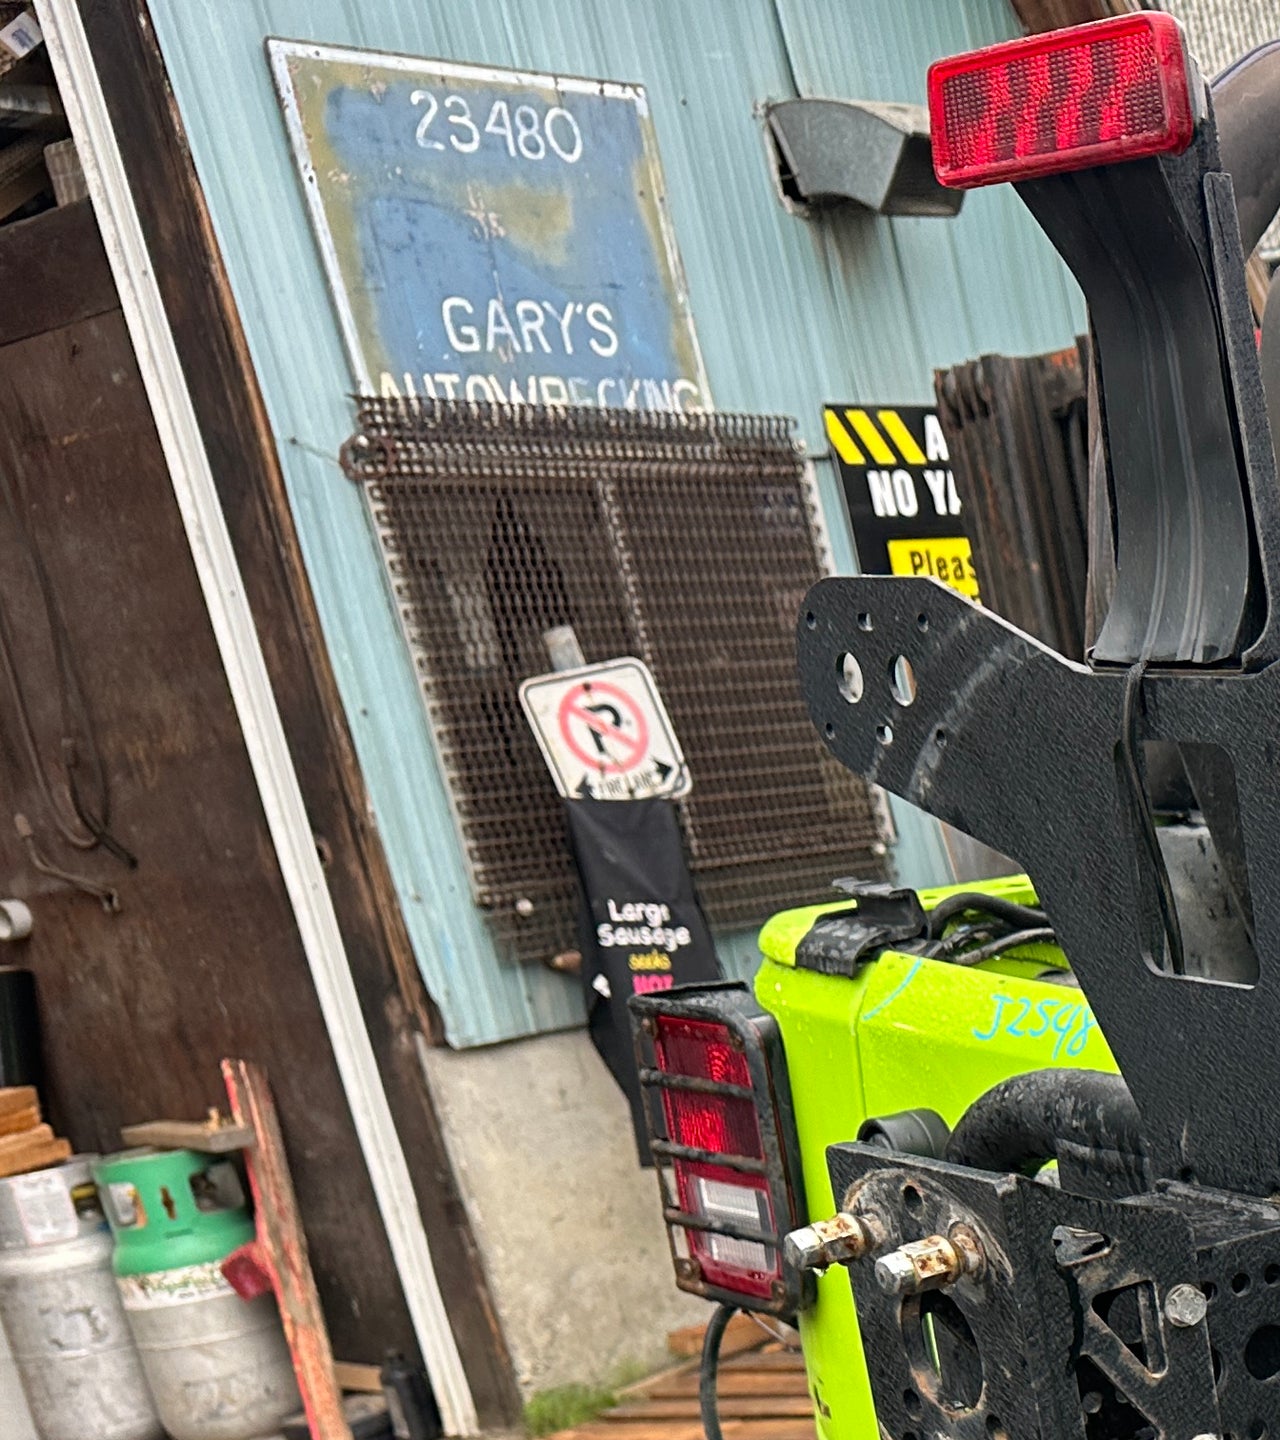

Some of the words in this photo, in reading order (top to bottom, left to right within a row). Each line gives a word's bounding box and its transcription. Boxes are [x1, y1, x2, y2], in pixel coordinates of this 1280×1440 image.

[410, 89, 583, 164] 23480
[441, 296, 619, 357] GARY'S
[866, 468, 919, 518] NO
[597, 922, 692, 952] Sausage
